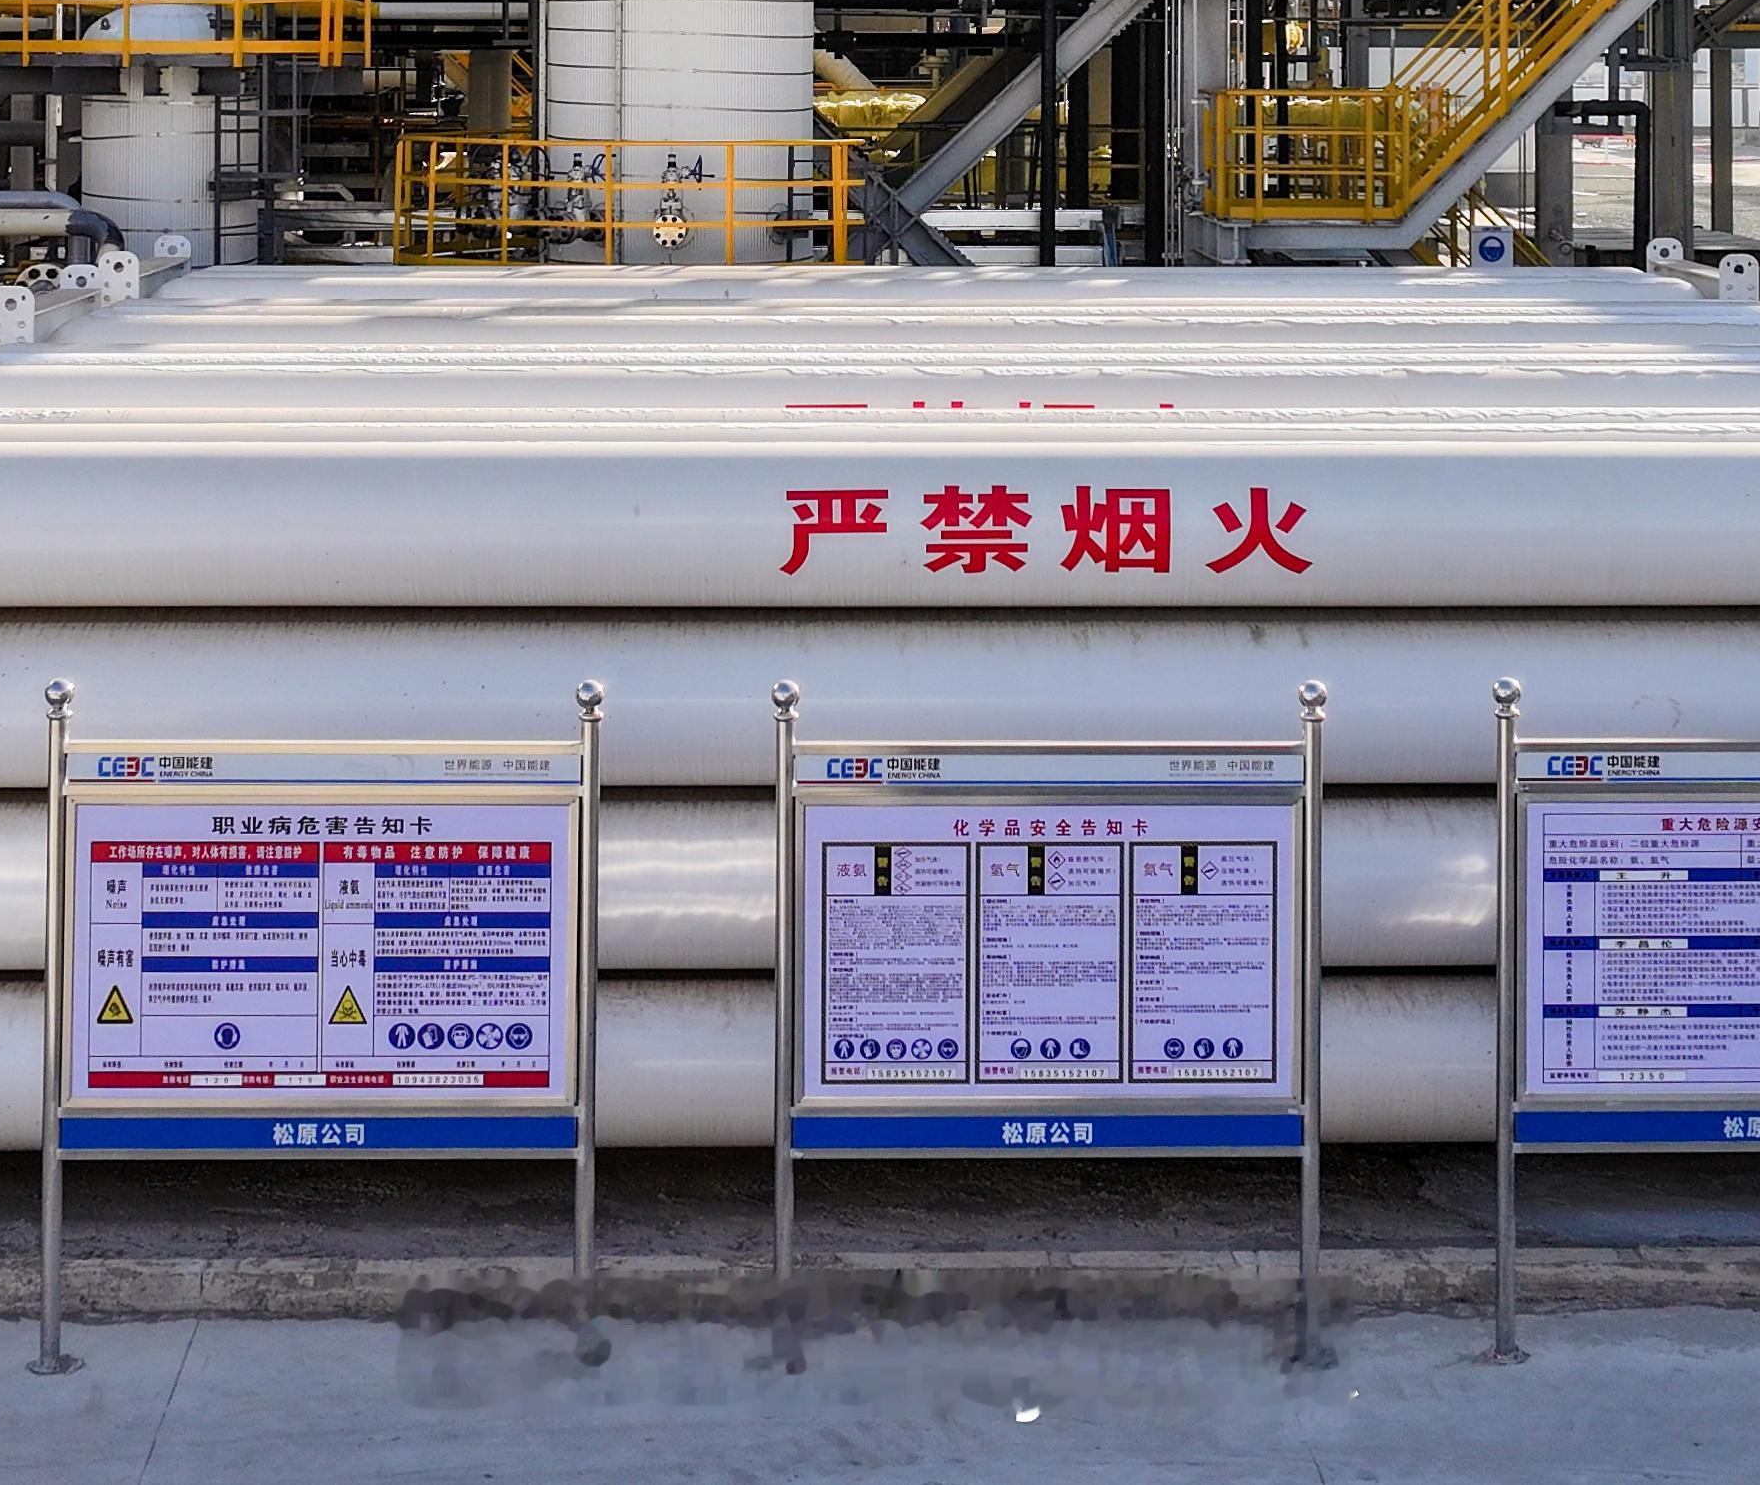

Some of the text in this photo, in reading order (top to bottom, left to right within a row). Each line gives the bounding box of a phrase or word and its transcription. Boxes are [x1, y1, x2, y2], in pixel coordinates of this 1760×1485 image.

[779, 485, 1314, 576] 严禁烟火
[159, 756, 214, 770] 中国能建
[443, 759, 551, 770] 世界能源 中国能建
[886, 757, 941, 772] 中国能建
[1169, 759, 1274, 771] 世界能源 中国能建
[1606, 754, 1661, 769] 中国能建
[211, 815, 433, 836] 职业病危害告知卡
[953, 818, 1150, 837] 化学品安全告知卡
[342, 845, 531, 860] 有毒物品 注意防护 保障健康
[836, 863, 867, 877] 液氨
[990, 863, 1020, 877] 氢气
[106, 879, 127, 895] 噪声
[338, 880, 360, 895] 液氨
[105, 898, 128, 910] Noise
[324, 899, 344, 913] Liquid
[97, 949, 134, 968] 噪声有害
[330, 949, 368, 968] 当心中毒
[1620, 1072, 1665, 1080] 12350
[272, 1123, 366, 1147] 松原公司
[1001, 1122, 1094, 1145] 松原公司
